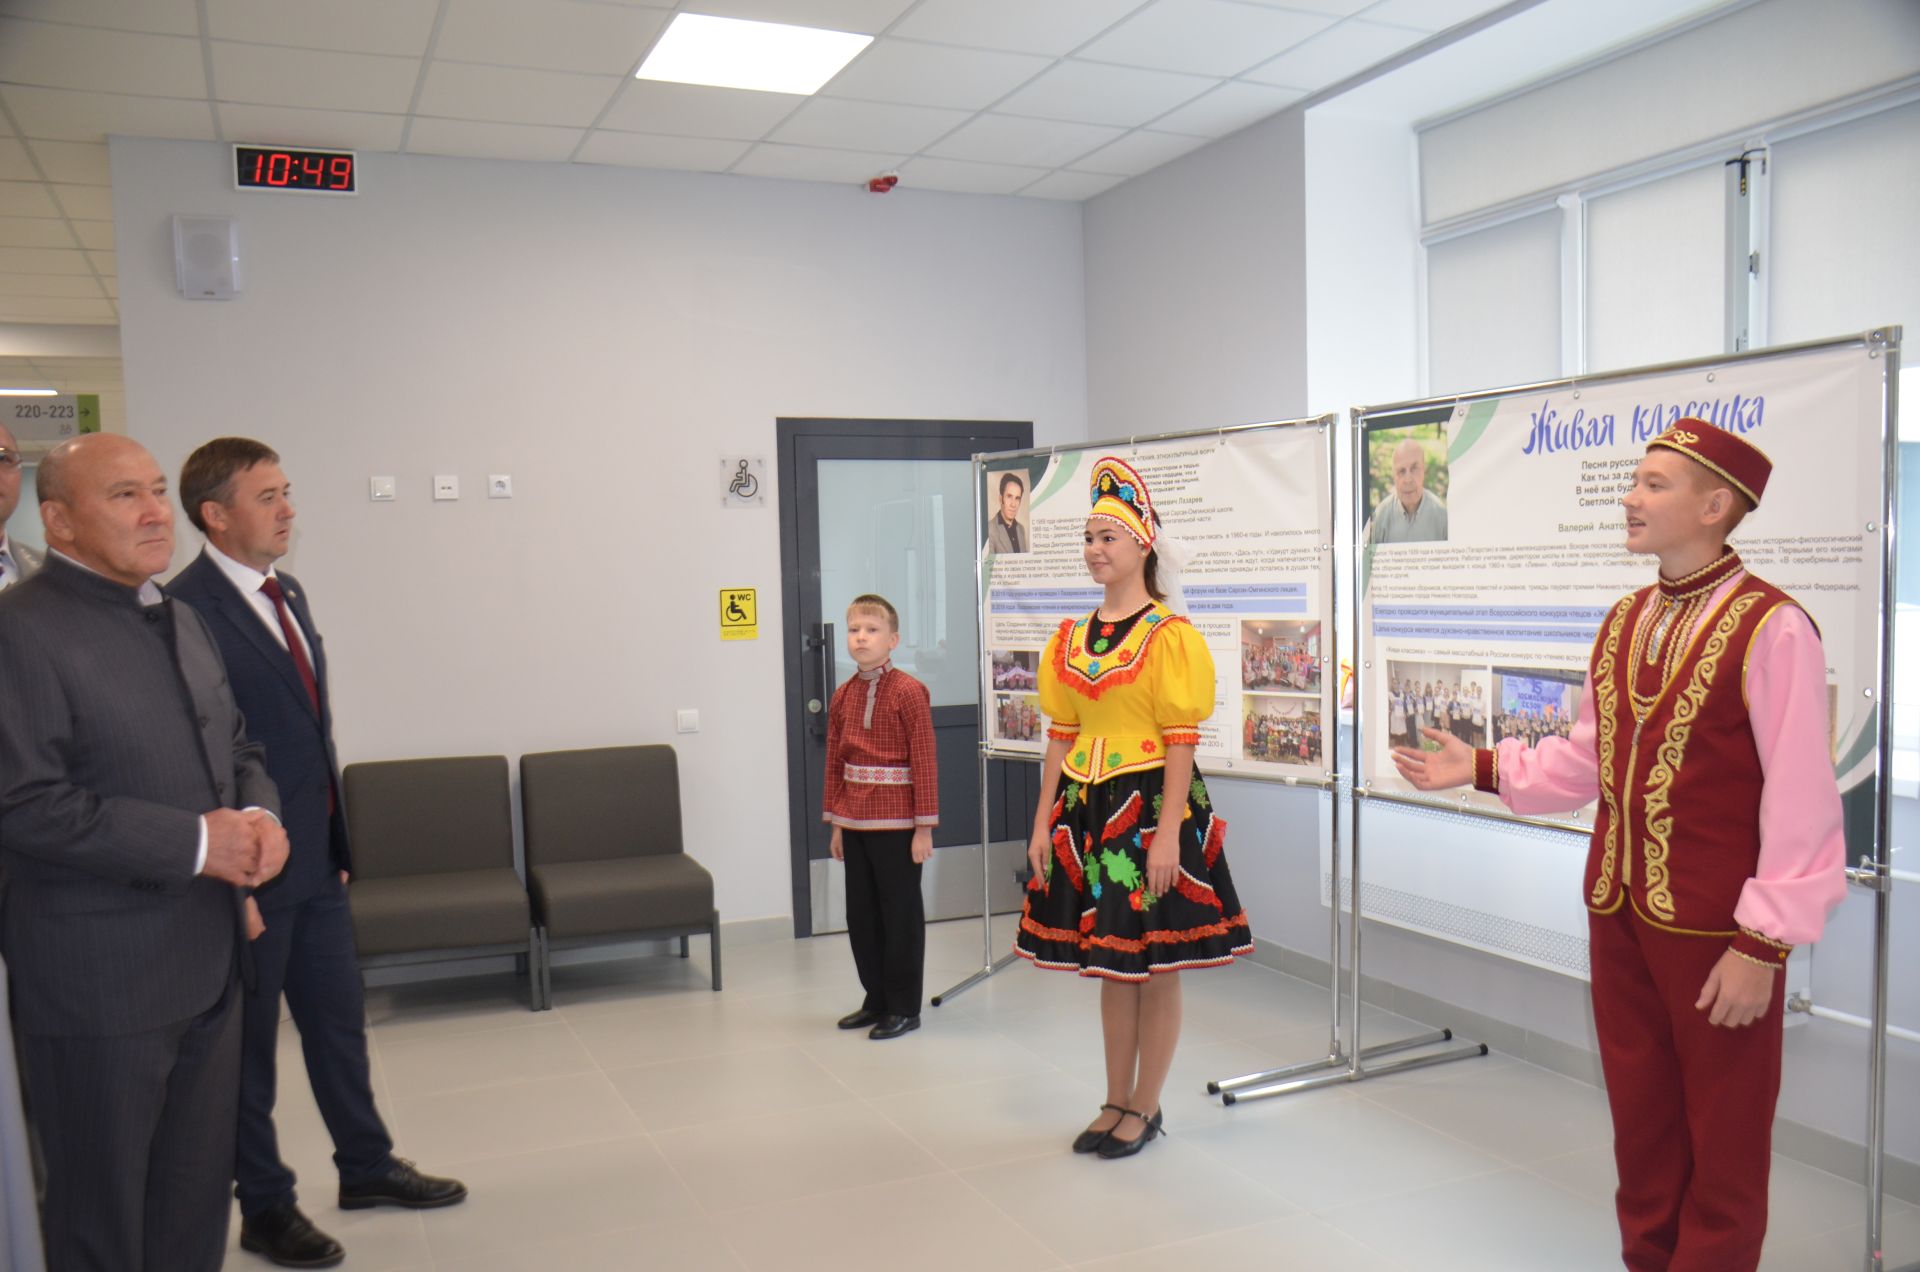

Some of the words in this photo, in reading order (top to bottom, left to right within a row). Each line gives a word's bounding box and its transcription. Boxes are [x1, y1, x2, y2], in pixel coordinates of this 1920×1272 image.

[254, 154, 351, 188] 10:49
[16, 405, 74, 418] 220-223
[1522, 399, 1615, 455] Живая
[1581, 460, 1608, 470] Песня
[1581, 473, 1597, 482] Как
[1598, 473, 1610, 482] ты
[1623, 471, 1634, 482] ду
[1575, 486, 1582, 495] В
[1584, 484, 1599, 494] неё
[1601, 485, 1615, 493] как
[1617, 482, 1633, 494] буд
[1178, 497, 1203, 505] Лазарев
[1579, 497, 1615, 507] Светлой
[1558, 522, 1594, 533] Валерий
[1598, 521, 1628, 531] Анатол
[1762, 534, 1863, 545] историко-филологический
[1778, 546, 1813, 555] Первыми
[1792, 556, 1839, 564] серебряный
[1813, 583, 1861, 592] Федерации,
[1489, 609, 1537, 617] Всероссийского
[1539, 610, 1568, 618] конкурса
[1569, 610, 1591, 618] чтецов
[1544, 630, 1580, 638] школьников
[1511, 653, 1533, 661] конкурс
